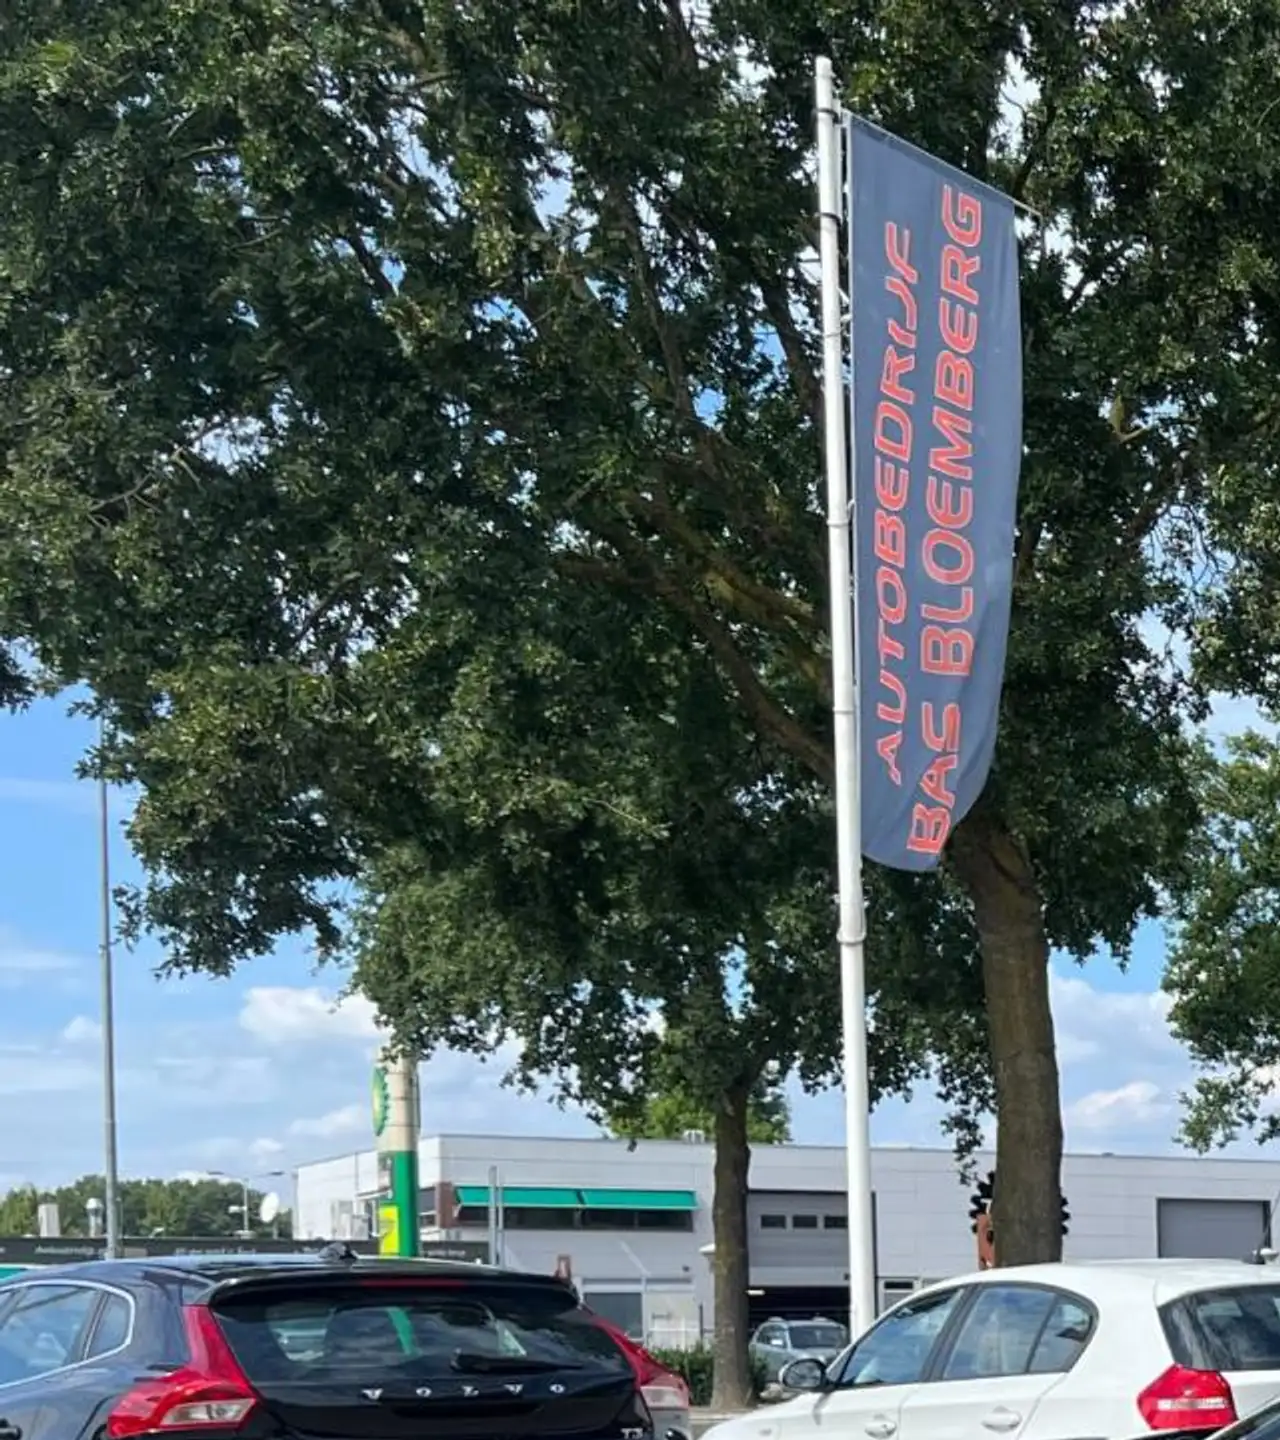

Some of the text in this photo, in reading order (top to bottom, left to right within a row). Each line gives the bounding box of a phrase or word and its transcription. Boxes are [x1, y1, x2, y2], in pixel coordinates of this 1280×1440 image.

[873, 220, 919, 786] AUTOBEDRIJF
[906, 183, 983, 855] BAS BLOEMBERG
[361, 1382, 566, 1401] VOLVO
